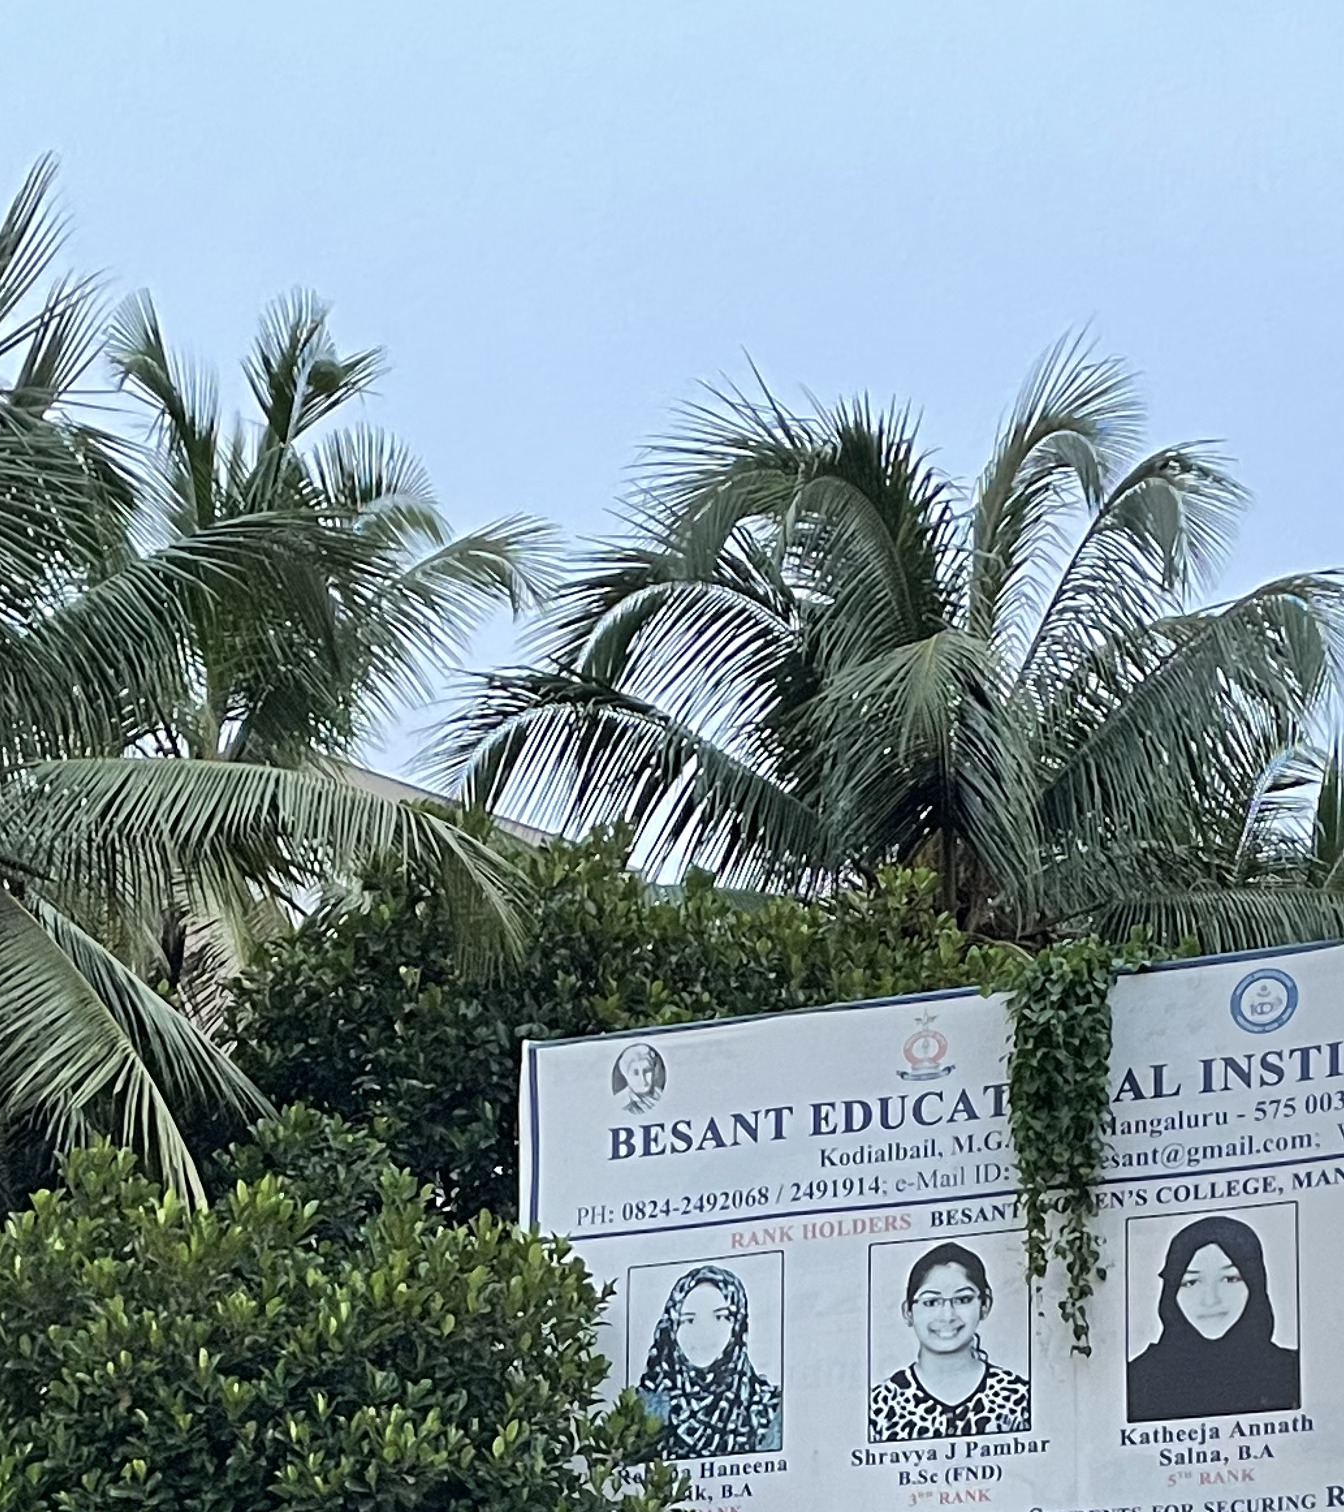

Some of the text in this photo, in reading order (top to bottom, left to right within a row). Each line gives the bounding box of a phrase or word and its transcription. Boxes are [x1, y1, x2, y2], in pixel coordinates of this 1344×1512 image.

[608, 1105, 794, 1161] BESANT
[809, 1062, 1182, 1137] EDUCATAL
[819, 1137, 944, 1169] Kodialbail,
[1253, 1098, 1297, 1122] 575
[576, 1206, 615, 1227] PH:
[621, 1185, 770, 1222] 0824-2492068
[894, 1165, 965, 1192] e-Mail
[975, 1164, 1011, 1184] ID:
[1154, 1175, 1285, 1204] COLLEGE,
[730, 1213, 912, 1249] RANK HOLDERS
[1119, 1414, 1314, 1446] Katheeja Annath
[966, 1436, 1050, 1461] Pambar
[1159, 1443, 1275, 1468] Salna, B.A
[699, 1456, 788, 1480] Haneena
[944, 1464, 1003, 1486] (FND)
[1200, 1467, 1256, 1486] RANK
[938, 1487, 992, 1505] RANK
